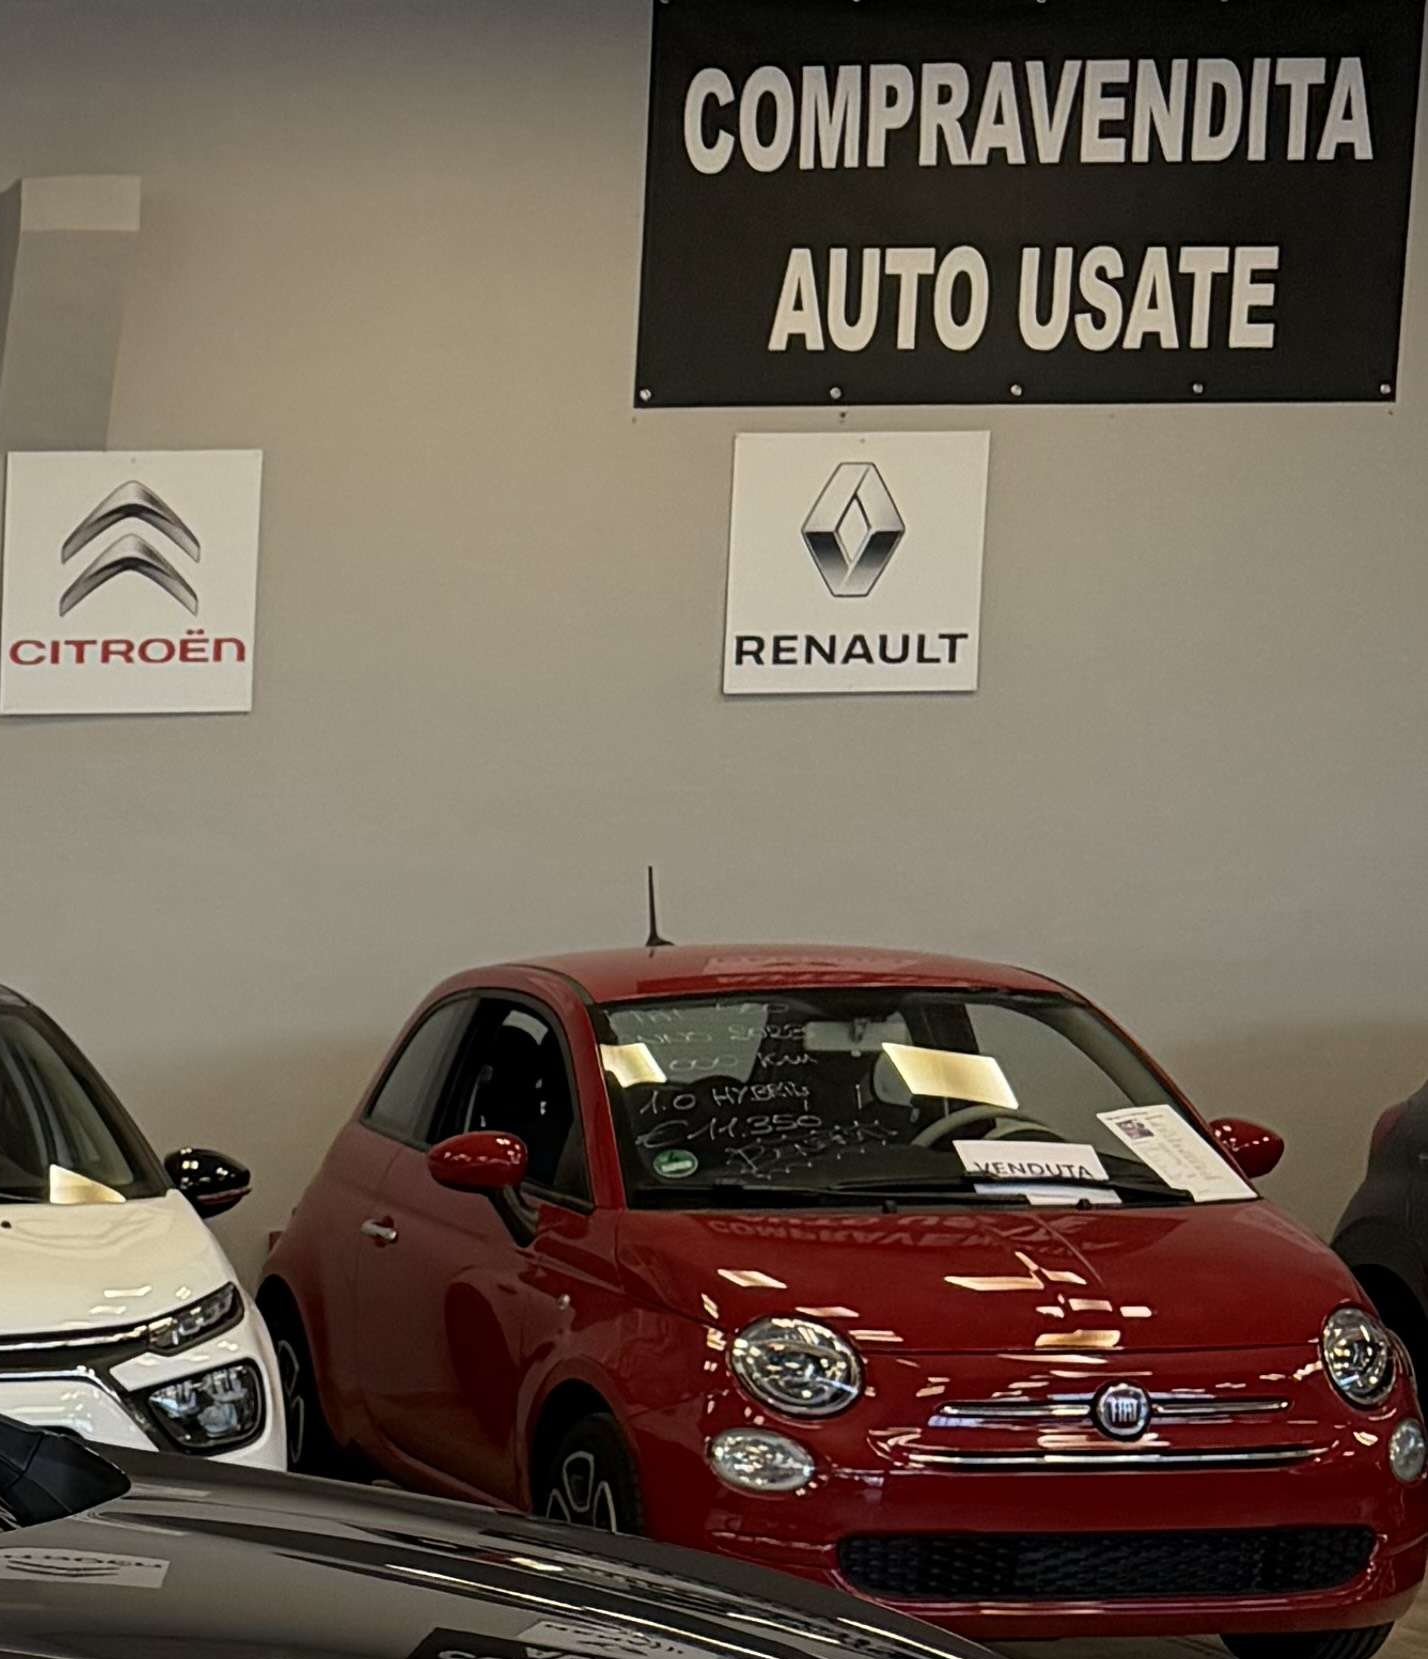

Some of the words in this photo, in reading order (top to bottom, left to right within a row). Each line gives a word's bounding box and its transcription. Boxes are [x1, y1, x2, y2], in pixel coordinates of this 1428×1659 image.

[683, 57, 1374, 174] COMPRAVENDITA
[768, 245, 990, 352] AUTO
[1018, 245, 1280, 352] USATE
[734, 632, 969, 667] RENAULT
[973, 1159, 1093, 1180] VENDUTA
